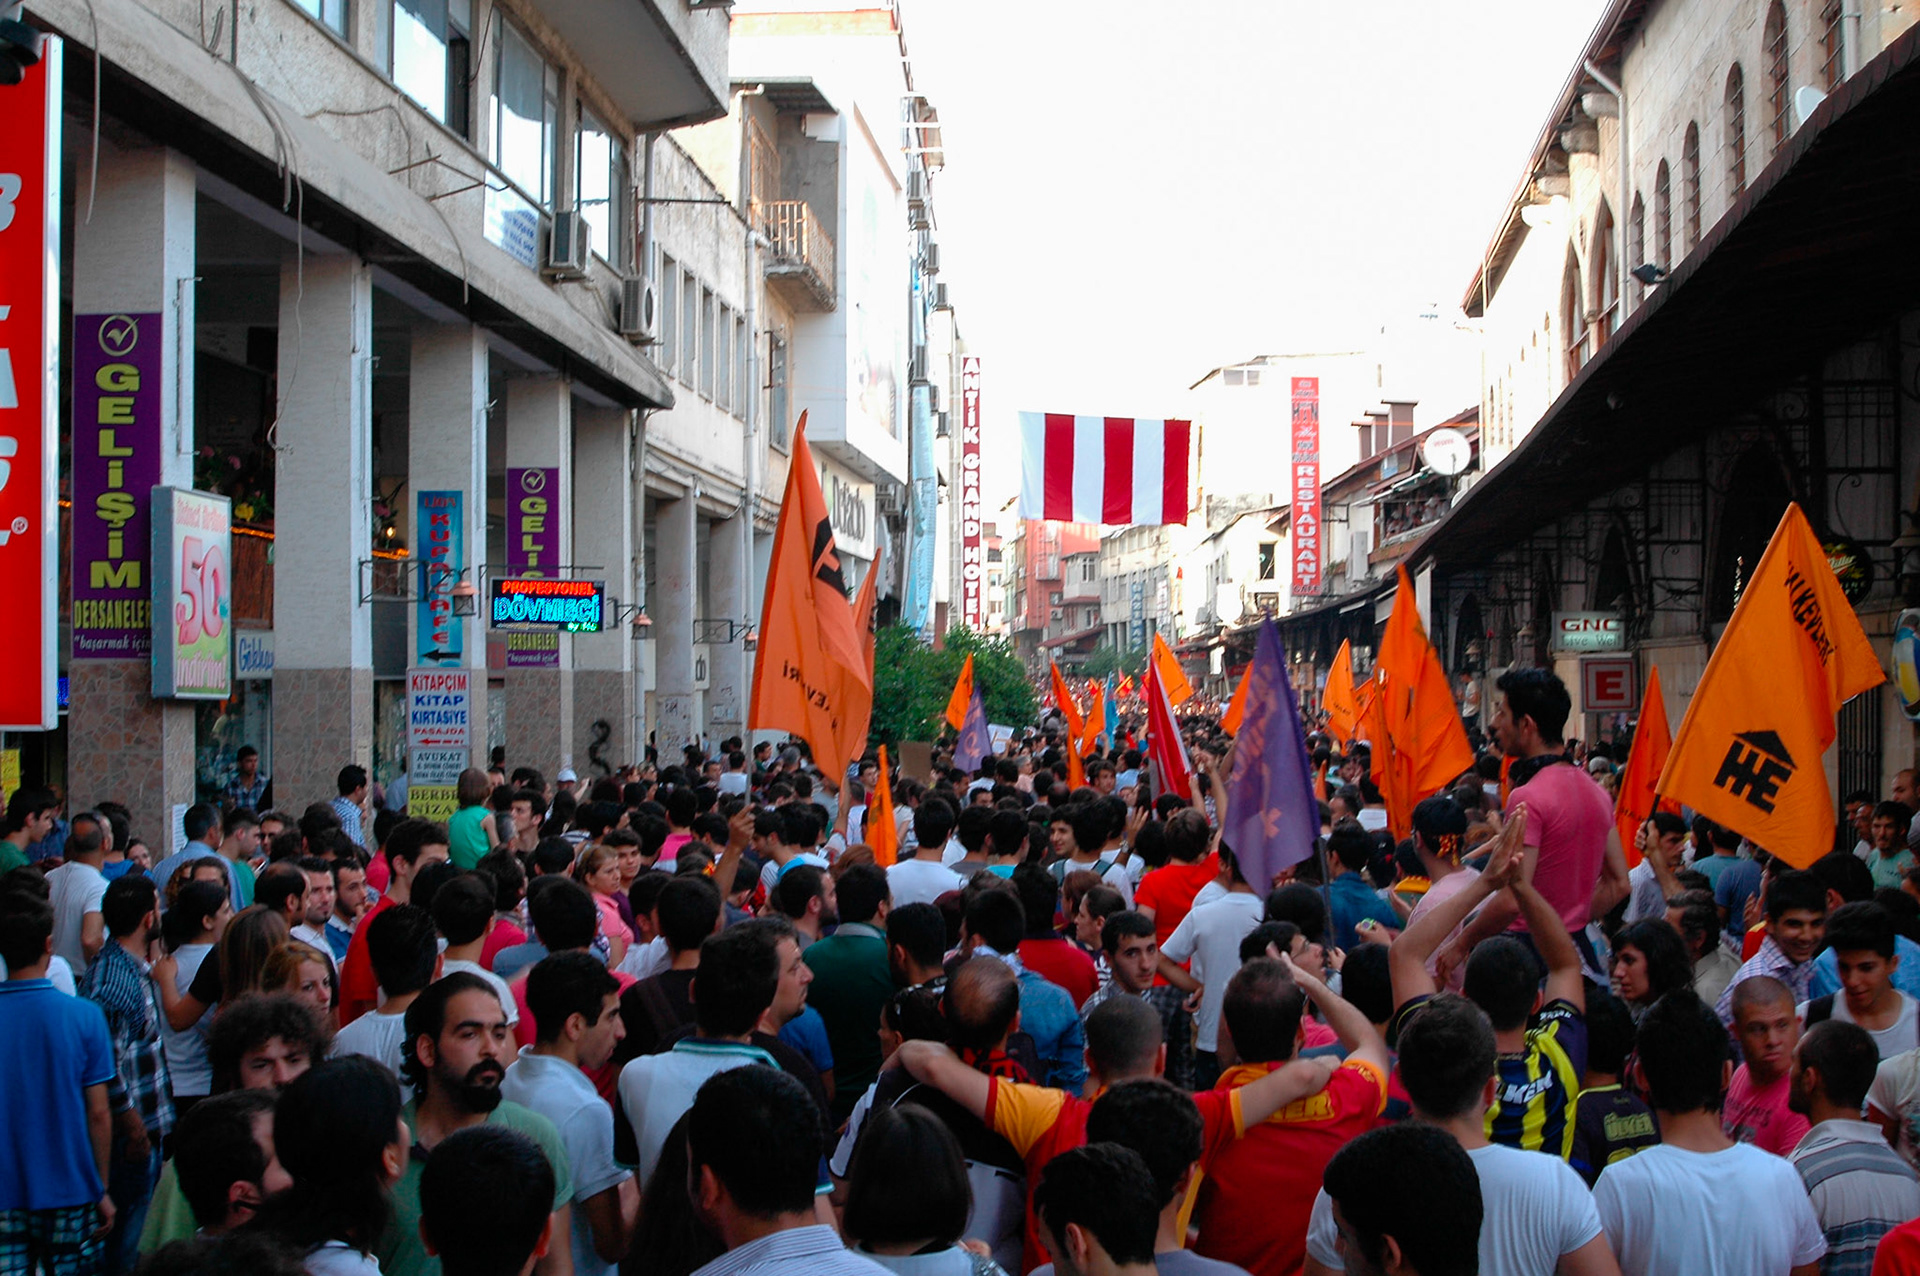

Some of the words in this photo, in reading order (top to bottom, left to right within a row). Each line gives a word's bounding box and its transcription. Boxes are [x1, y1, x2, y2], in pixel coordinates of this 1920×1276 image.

[963, 358, 980, 444] ANTİK
[89, 362, 142, 590] GELİŞİM
[963, 453, 980, 537] GRAND
[519, 496, 549, 578] GELİ
[1296, 466, 1316, 586] RESTAURANT
[502, 580, 597, 596] PROFESYONEL
[963, 547, 980, 630] HOTEL
[494, 592, 600, 623] DÖVMECİ
[1561, 618, 1620, 632] GNC
[411, 674, 467, 693] KİTAPÇIM
[1595, 670, 1625, 701] E
[415, 695, 464, 707] KİTAP
[411, 710, 467, 726] KIRTASİYE
[413, 728, 466, 736] PASAJDA
[417, 751, 463, 762] AVUKAT
